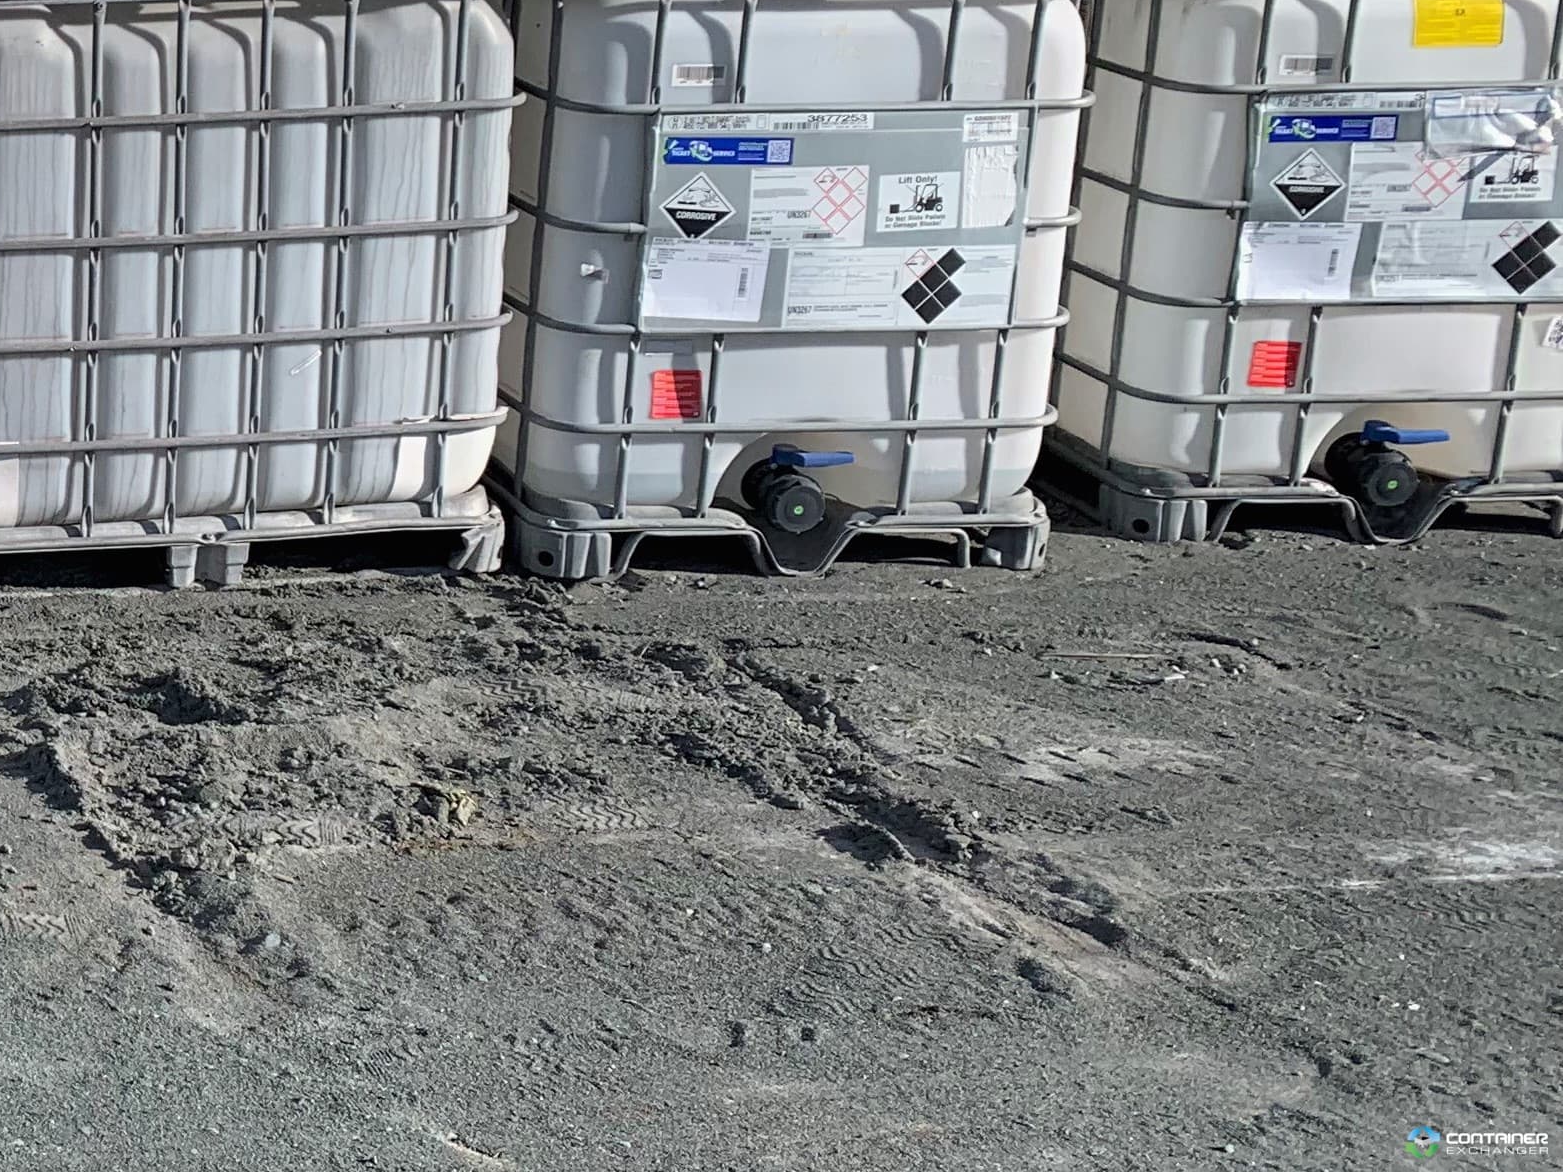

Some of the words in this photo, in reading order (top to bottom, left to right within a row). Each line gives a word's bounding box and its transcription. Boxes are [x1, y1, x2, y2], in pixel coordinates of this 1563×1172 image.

[807, 113, 869, 123] 3877253
[898, 176, 913, 185] Lift
[915, 174, 938, 184] Only!
[675, 210, 718, 221] CORROSIVE
